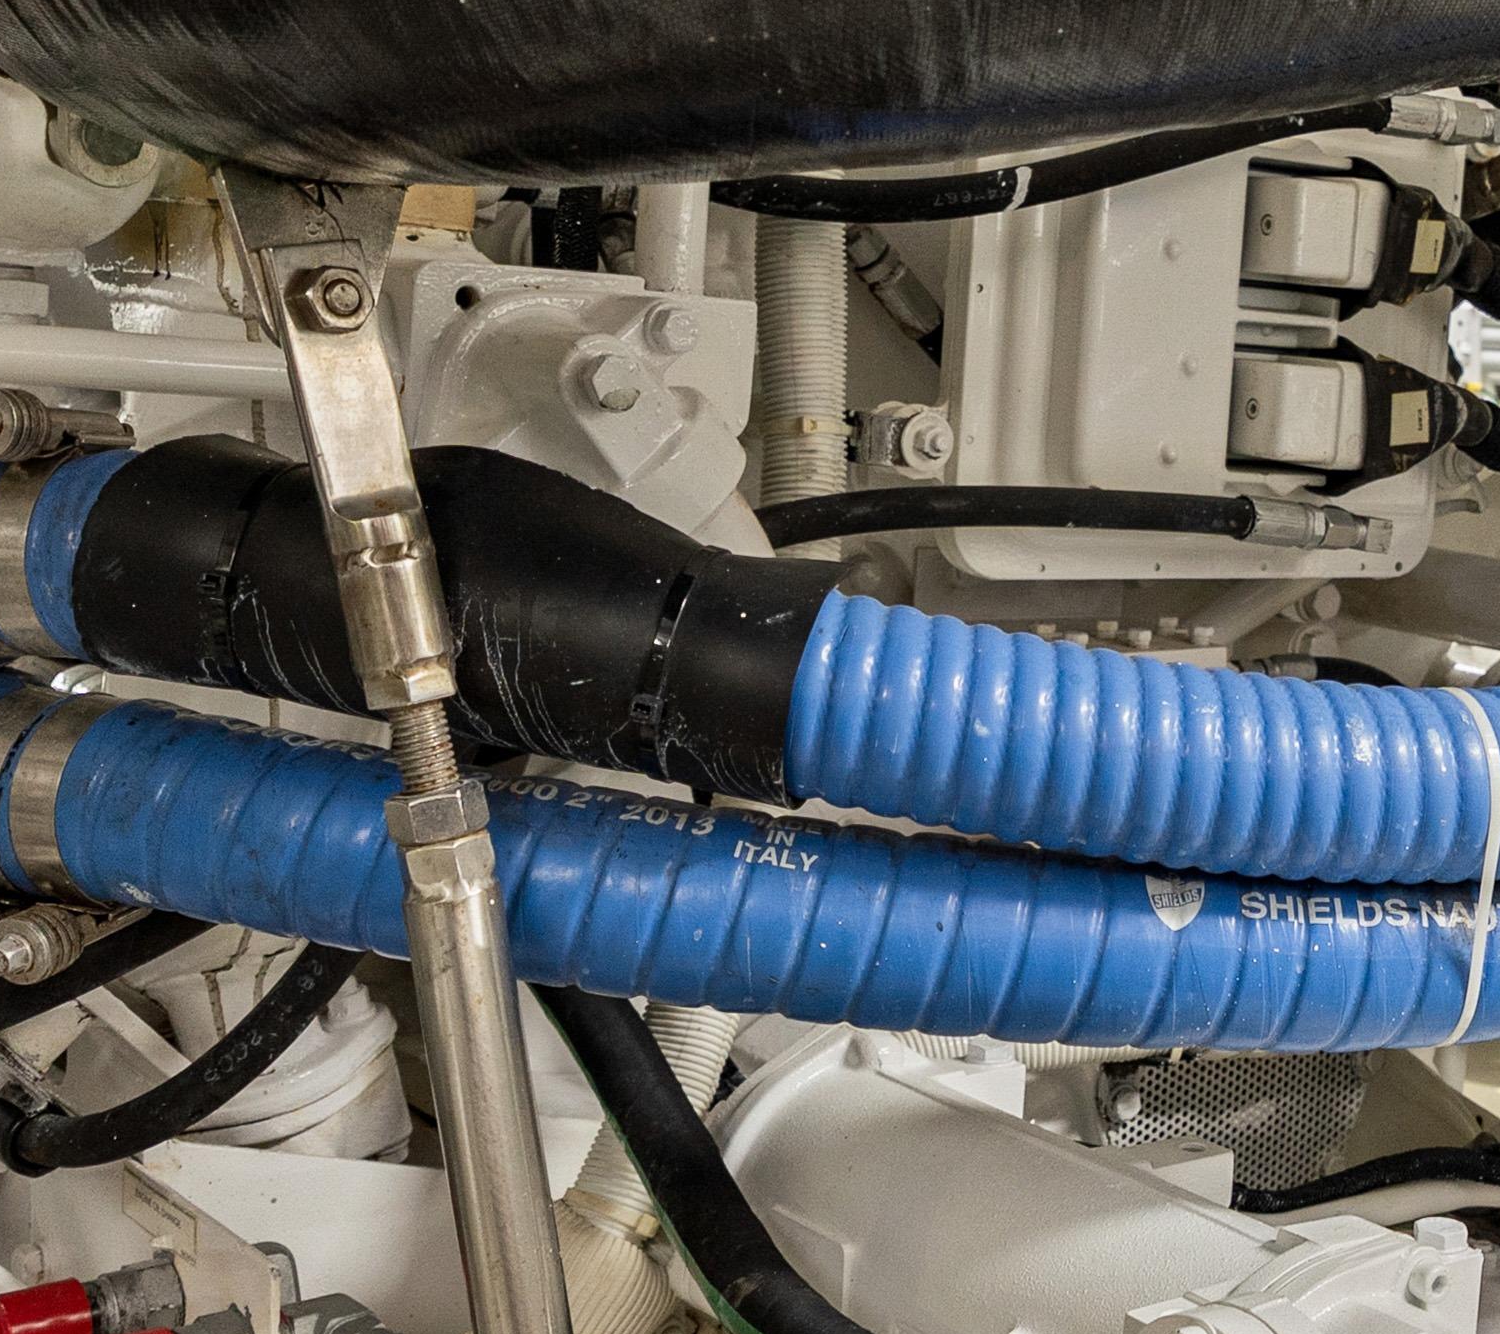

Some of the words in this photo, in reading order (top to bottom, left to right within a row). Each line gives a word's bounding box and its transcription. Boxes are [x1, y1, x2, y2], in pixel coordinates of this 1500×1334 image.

[620, 803, 715, 837] 2013
[767, 829, 794, 847] IN
[733, 840, 819, 873] ITALY
[1152, 887, 1201, 910] SHIELDS
[1241, 891, 1411, 929] SHIELDS
